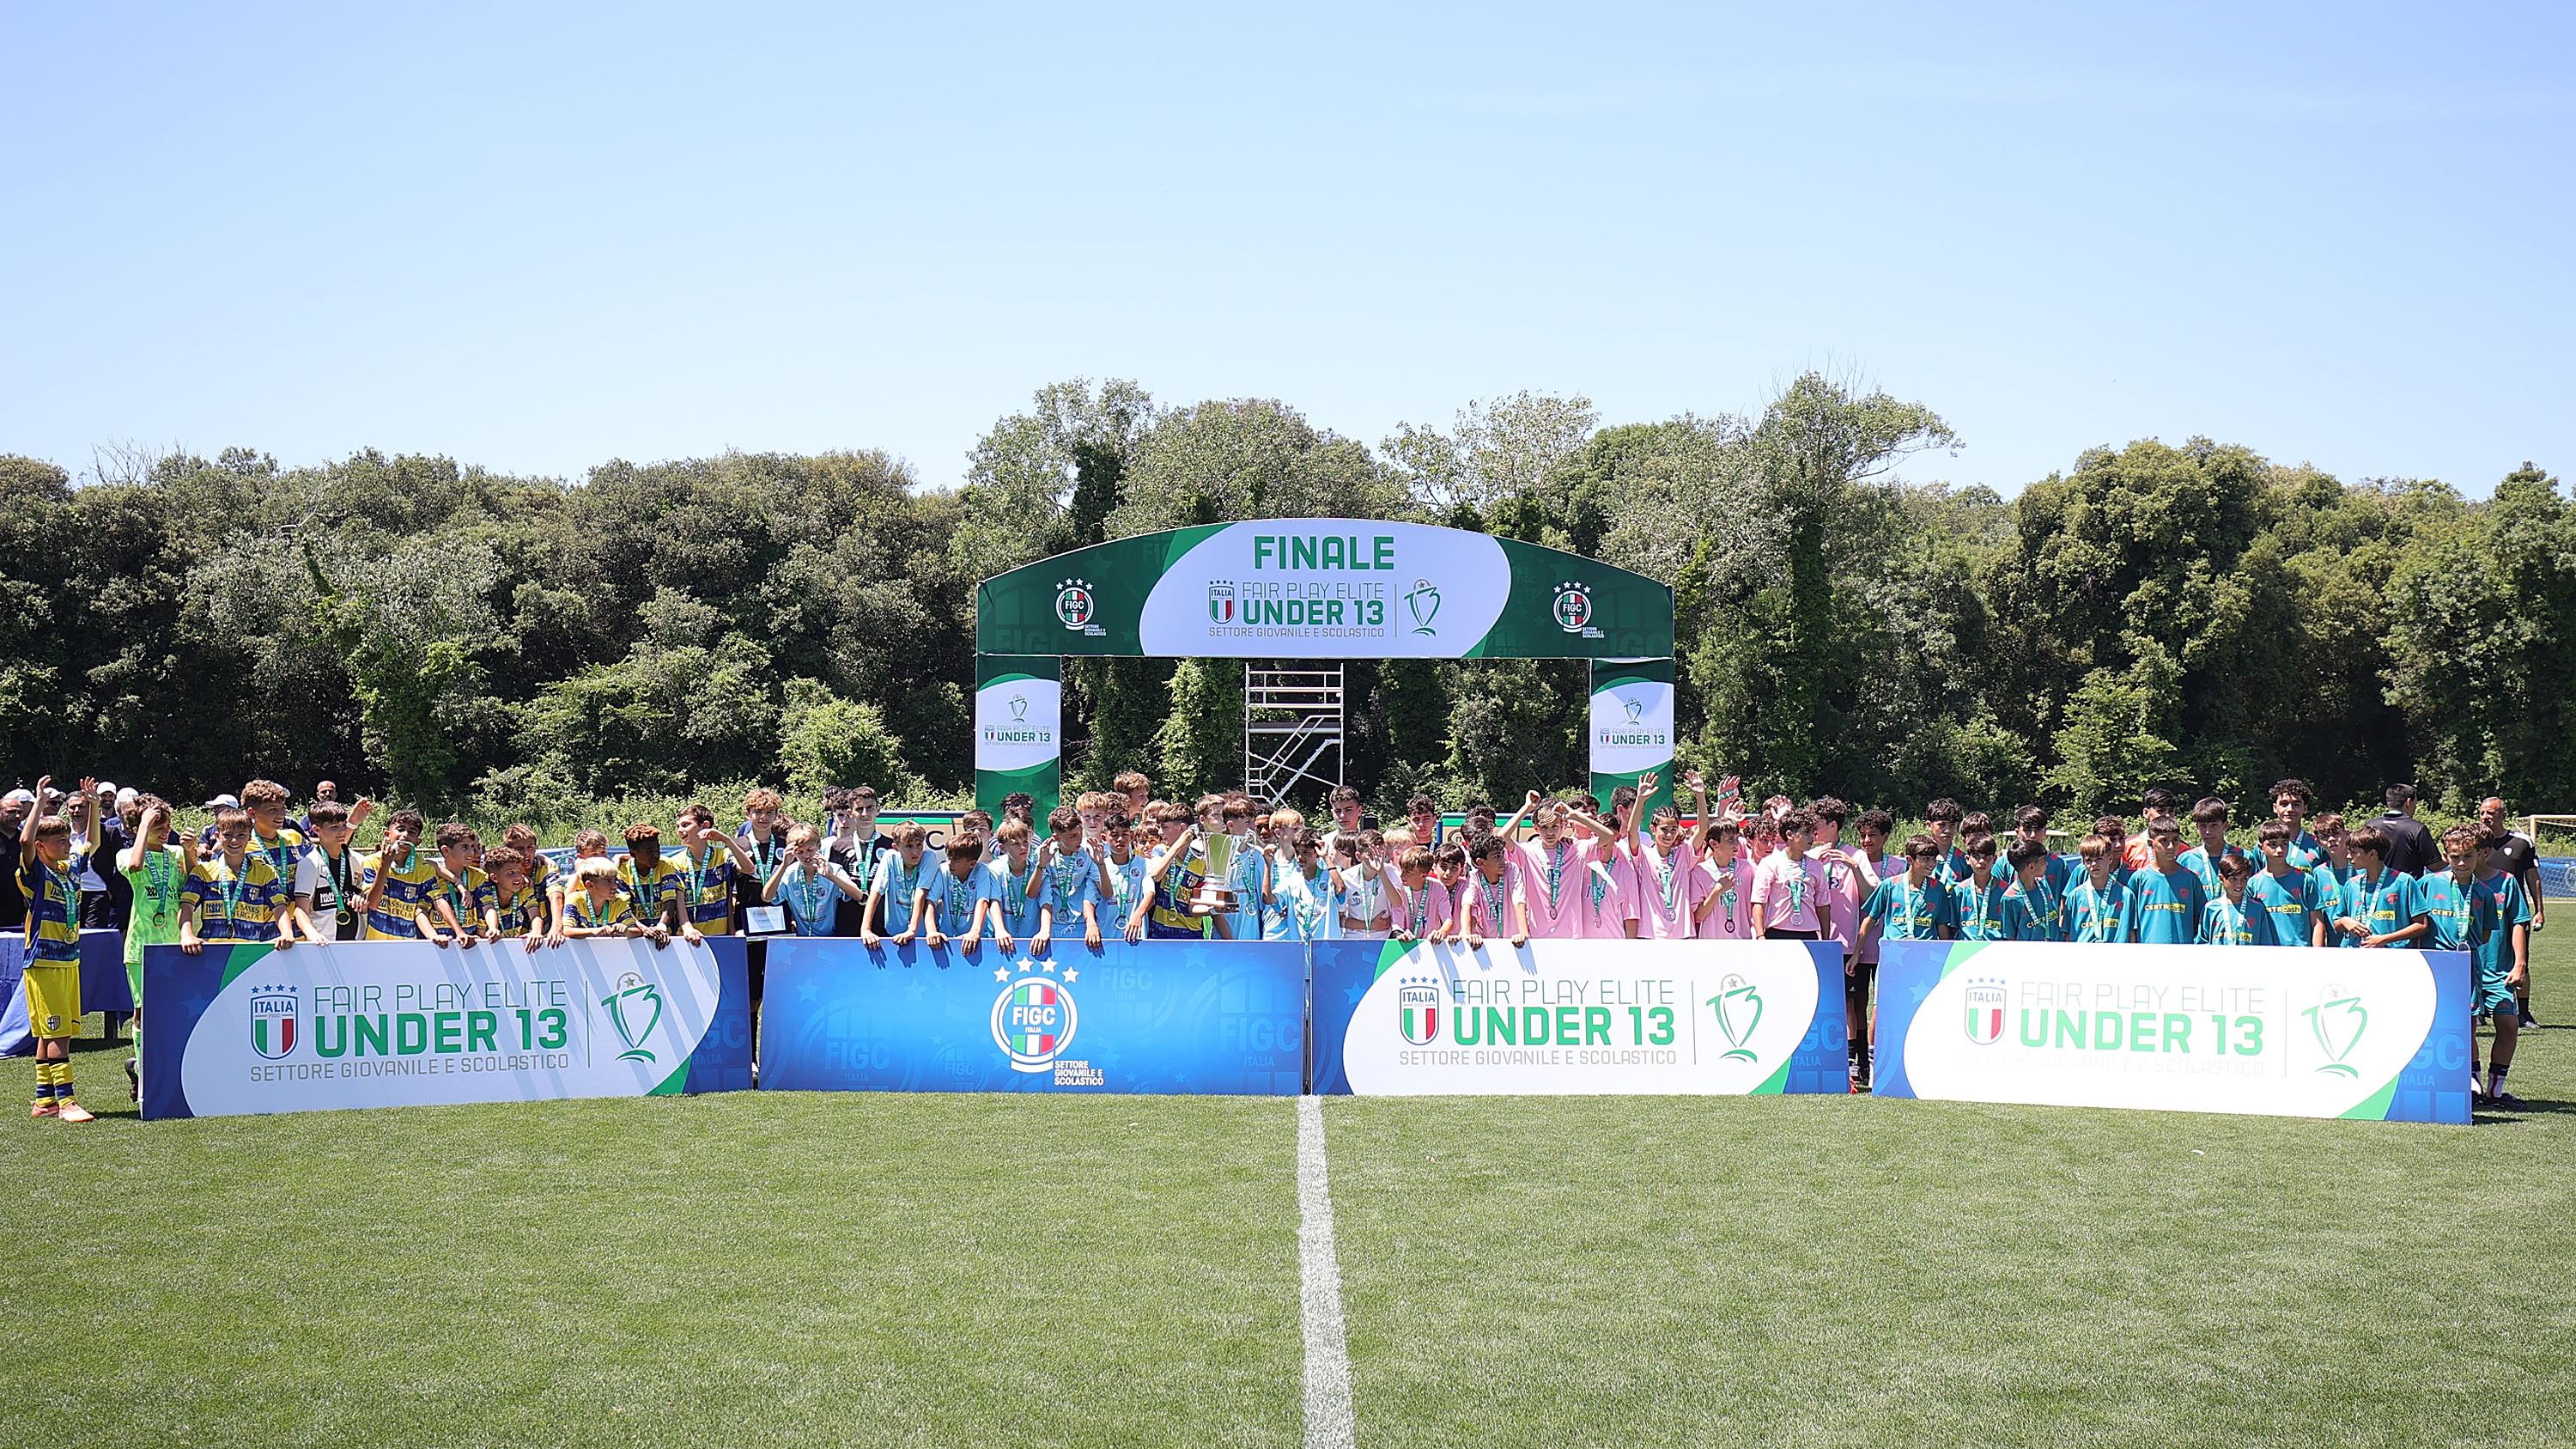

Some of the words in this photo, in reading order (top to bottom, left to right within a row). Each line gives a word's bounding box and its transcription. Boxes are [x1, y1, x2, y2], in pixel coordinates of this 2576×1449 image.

[1255, 536, 1394, 569] FINALE
[1211, 588, 1232, 597] ITALIA
[1242, 582, 1279, 599] FAIR
[1287, 582, 1328, 599] PLAY
[1342, 582, 1384, 600] ELITE
[1065, 600, 1084, 610] FIGC
[1563, 603, 1583, 612] FIGC
[1242, 600, 1344, 625] UNDER
[1353, 600, 1384, 625] 13
[1209, 627, 1254, 637] SETTORE
[1257, 627, 1310, 637] GIOVANILE
[1313, 628, 1319, 637] E
[1321, 627, 1384, 638] SCOLASTICO
[997, 732, 1036, 741] UNDER
[1039, 732, 1051, 742] 13
[1612, 734, 1650, 745] UNDER
[1653, 735, 1665, 745] 13
[315, 985, 381, 1014] FAIR
[397, 983, 471, 1011] PLAY
[485, 981, 567, 1008] ELITE
[1402, 992, 1436, 1002] ITALIA
[1453, 980, 1510, 1004] FAIR
[1523, 980, 1589, 1004] PLAY
[1601, 980, 1674, 1004] ELITE
[1969, 991, 2002, 1003] ITALIA
[2022, 982, 2081, 1008] FAIR
[2096, 983, 2169, 1010] PLAY
[2182, 986, 2264, 1014] ELITE
[254, 1001, 294, 1014] ITALIA
[1012, 1006, 1056, 1026] FIGC
[315, 1010, 498, 1058] UNDER
[515, 1008, 568, 1050] 13
[1454, 1007, 1612, 1045] UNDER
[1628, 1007, 1674, 1045] 13
[2020, 1008, 2191, 1054] UNDER
[2211, 1014, 2263, 1056] 13
[1054, 1060, 1089, 1069] SETTORE
[1400, 1050, 1469, 1065] SETTORE
[1475, 1050, 1559, 1065] GIOVANILE
[1565, 1050, 1573, 1065] E
[1579, 1050, 1676, 1065] SCOLASTICO
[251, 1063, 334, 1082] SETTORE
[341, 1058, 438, 1078] GIOVANILE
[445, 1058, 454, 1074] E
[461, 1053, 568, 1073] SCOLASTICO
[1054, 1068, 1096, 1077] GIOVANILE
[1097, 1068, 1103, 1077] E
[1054, 1076, 1104, 1087] SCOLASTICO
